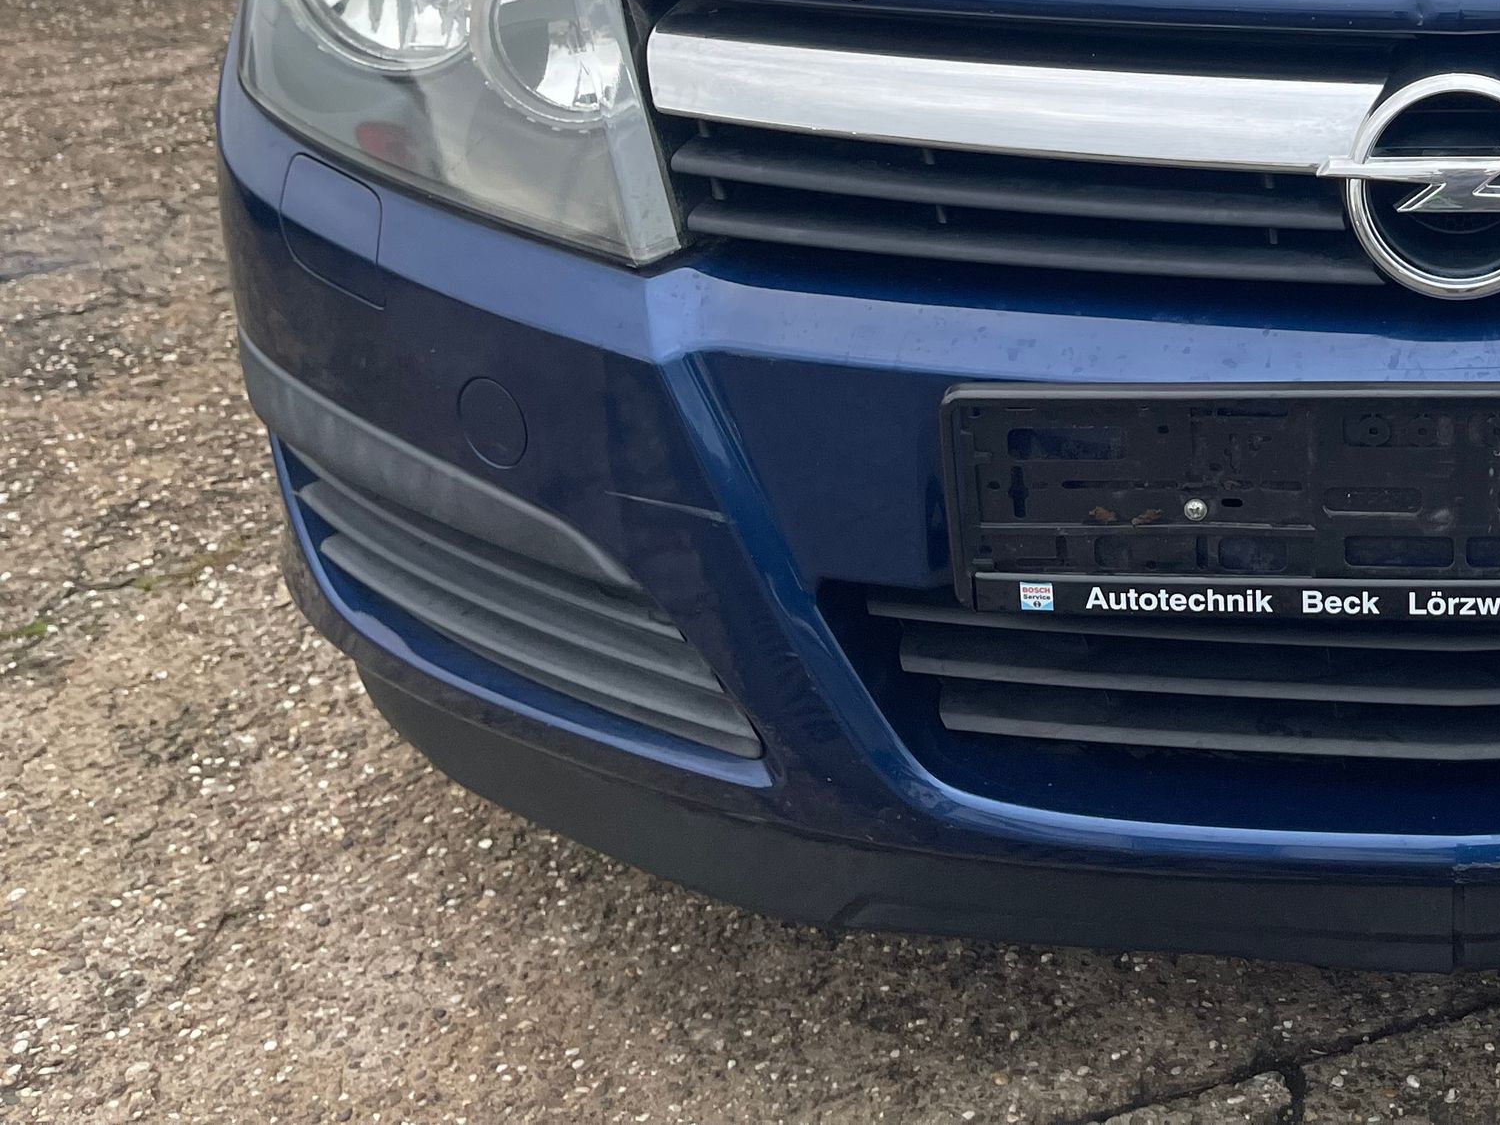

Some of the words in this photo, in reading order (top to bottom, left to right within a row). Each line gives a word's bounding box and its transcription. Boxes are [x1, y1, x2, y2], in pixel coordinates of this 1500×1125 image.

[1022, 586, 1051, 594] BOSCH
[1085, 586, 1274, 613] Autotechnik
[1301, 590, 1380, 615] Beck
